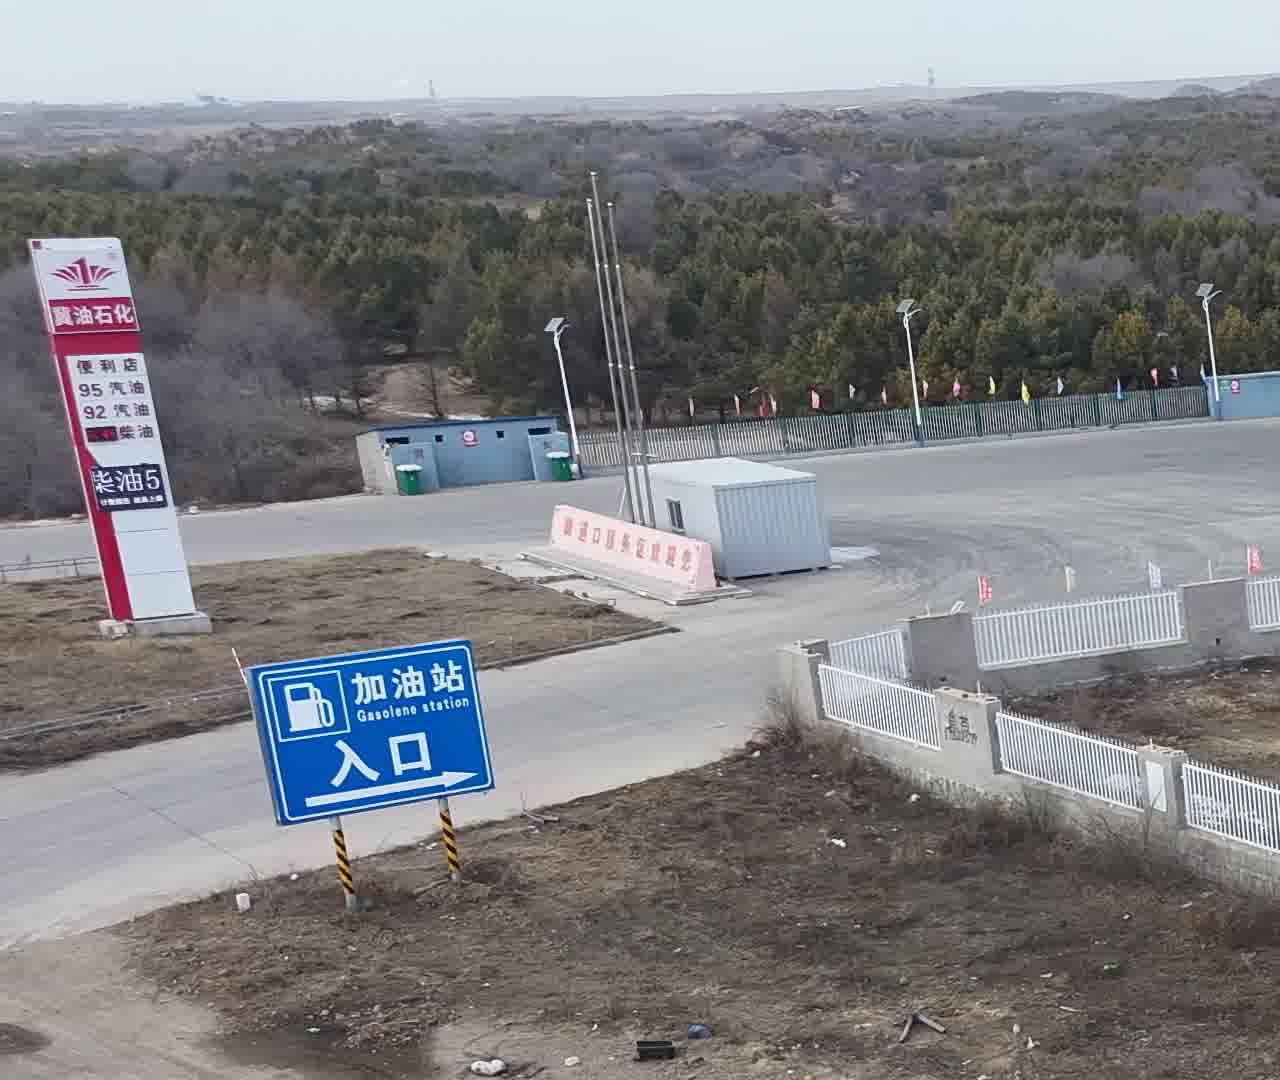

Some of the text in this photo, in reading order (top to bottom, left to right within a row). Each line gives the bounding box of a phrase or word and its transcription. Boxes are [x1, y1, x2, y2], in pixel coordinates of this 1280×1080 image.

[77, 358, 138, 374] 便利店
[79, 381, 145, 397] 95 汽油
[84, 402, 150, 419] 92 汽油
[119, 424, 154, 440] 柴油
[351, 659, 465, 706] 加油站
[356, 696, 470, 722] Gasolene station
[330, 731, 432, 788] 入口
